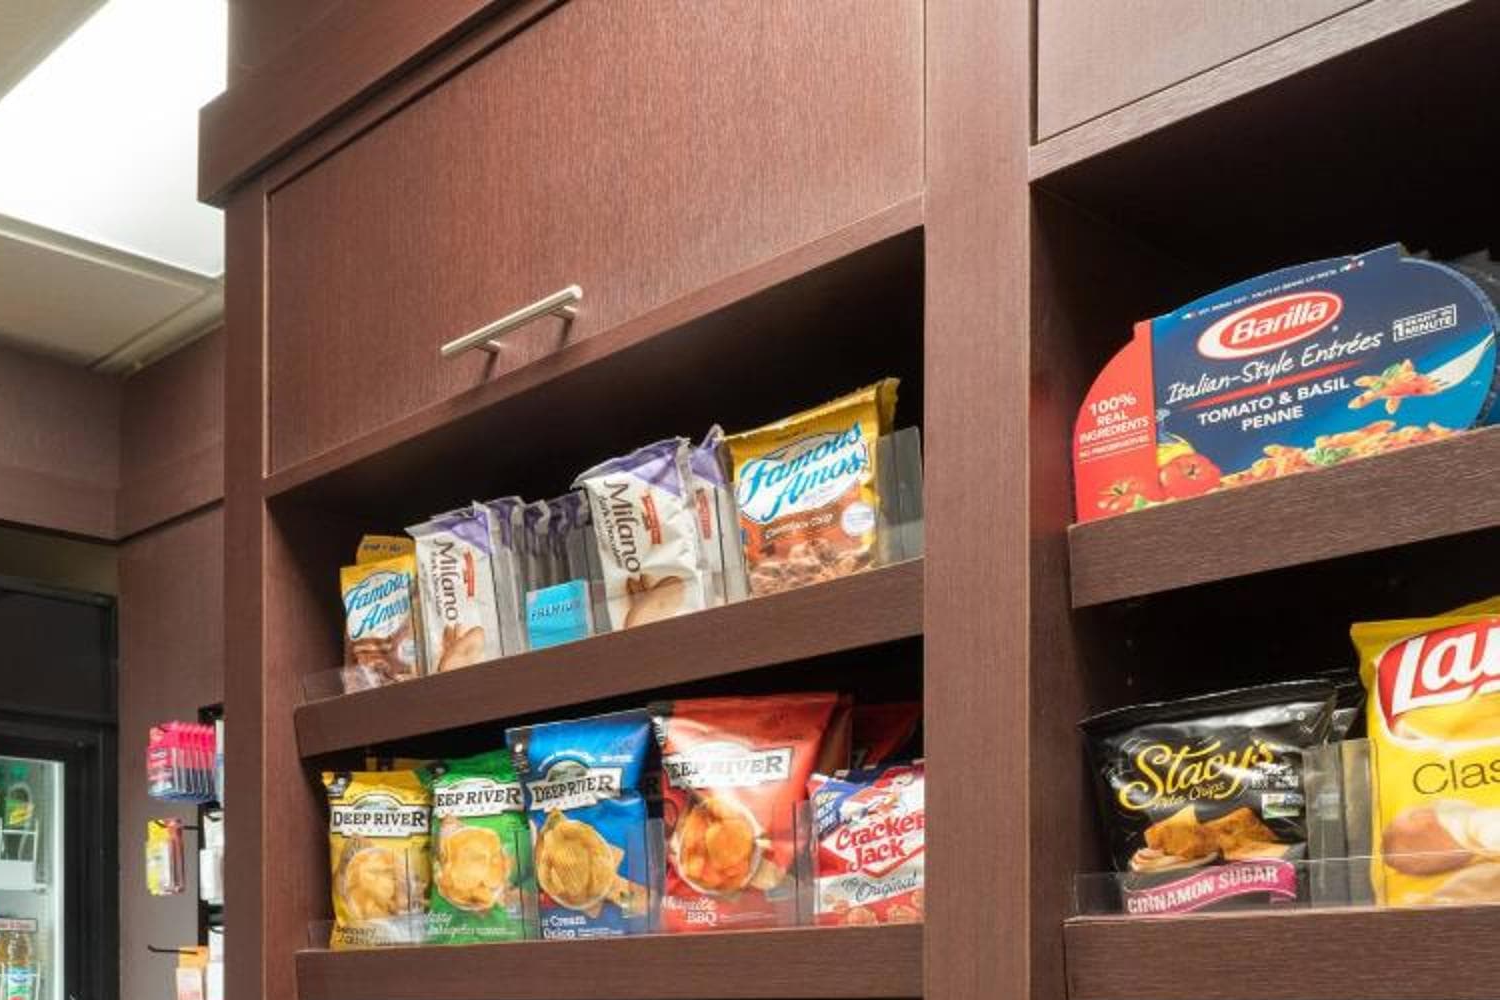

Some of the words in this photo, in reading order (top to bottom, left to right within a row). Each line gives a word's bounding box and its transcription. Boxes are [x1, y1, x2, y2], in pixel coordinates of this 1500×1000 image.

[1230, 300, 1328, 345] Barilla
[1166, 351, 1294, 405] Italian-Style
[1301, 331, 1384, 368] Entrées
[1090, 393, 1137, 415] 100%
[1096, 409, 1129, 427] REAL
[1199, 394, 1274, 425] TOMATO
[1278, 391, 1293, 405] &
[1297, 377, 1350, 402] BASIL
[1241, 406, 1304, 432] PENNE
[1079, 417, 1149, 444] INGREDIENTS
[740, 421, 862, 502] Famous
[761, 451, 867, 522] Amos
[604, 480, 642, 574] Milano
[433, 538, 461, 621] Milano
[533, 782, 567, 803] DEEP
[568, 774, 615, 796] RIVER
[1119, 740, 1274, 810] Stacy's
[435, 791, 461, 806] EEP
[465, 787, 522, 804] RIVER
[333, 811, 372, 826] DEEP
[374, 810, 426, 827] RIVER
[850, 838, 906, 872] Jack
[1127, 879, 1215, 914] CINNAMON
[1219, 865, 1279, 889] SUGAR
[687, 912, 718, 926] BBQ
